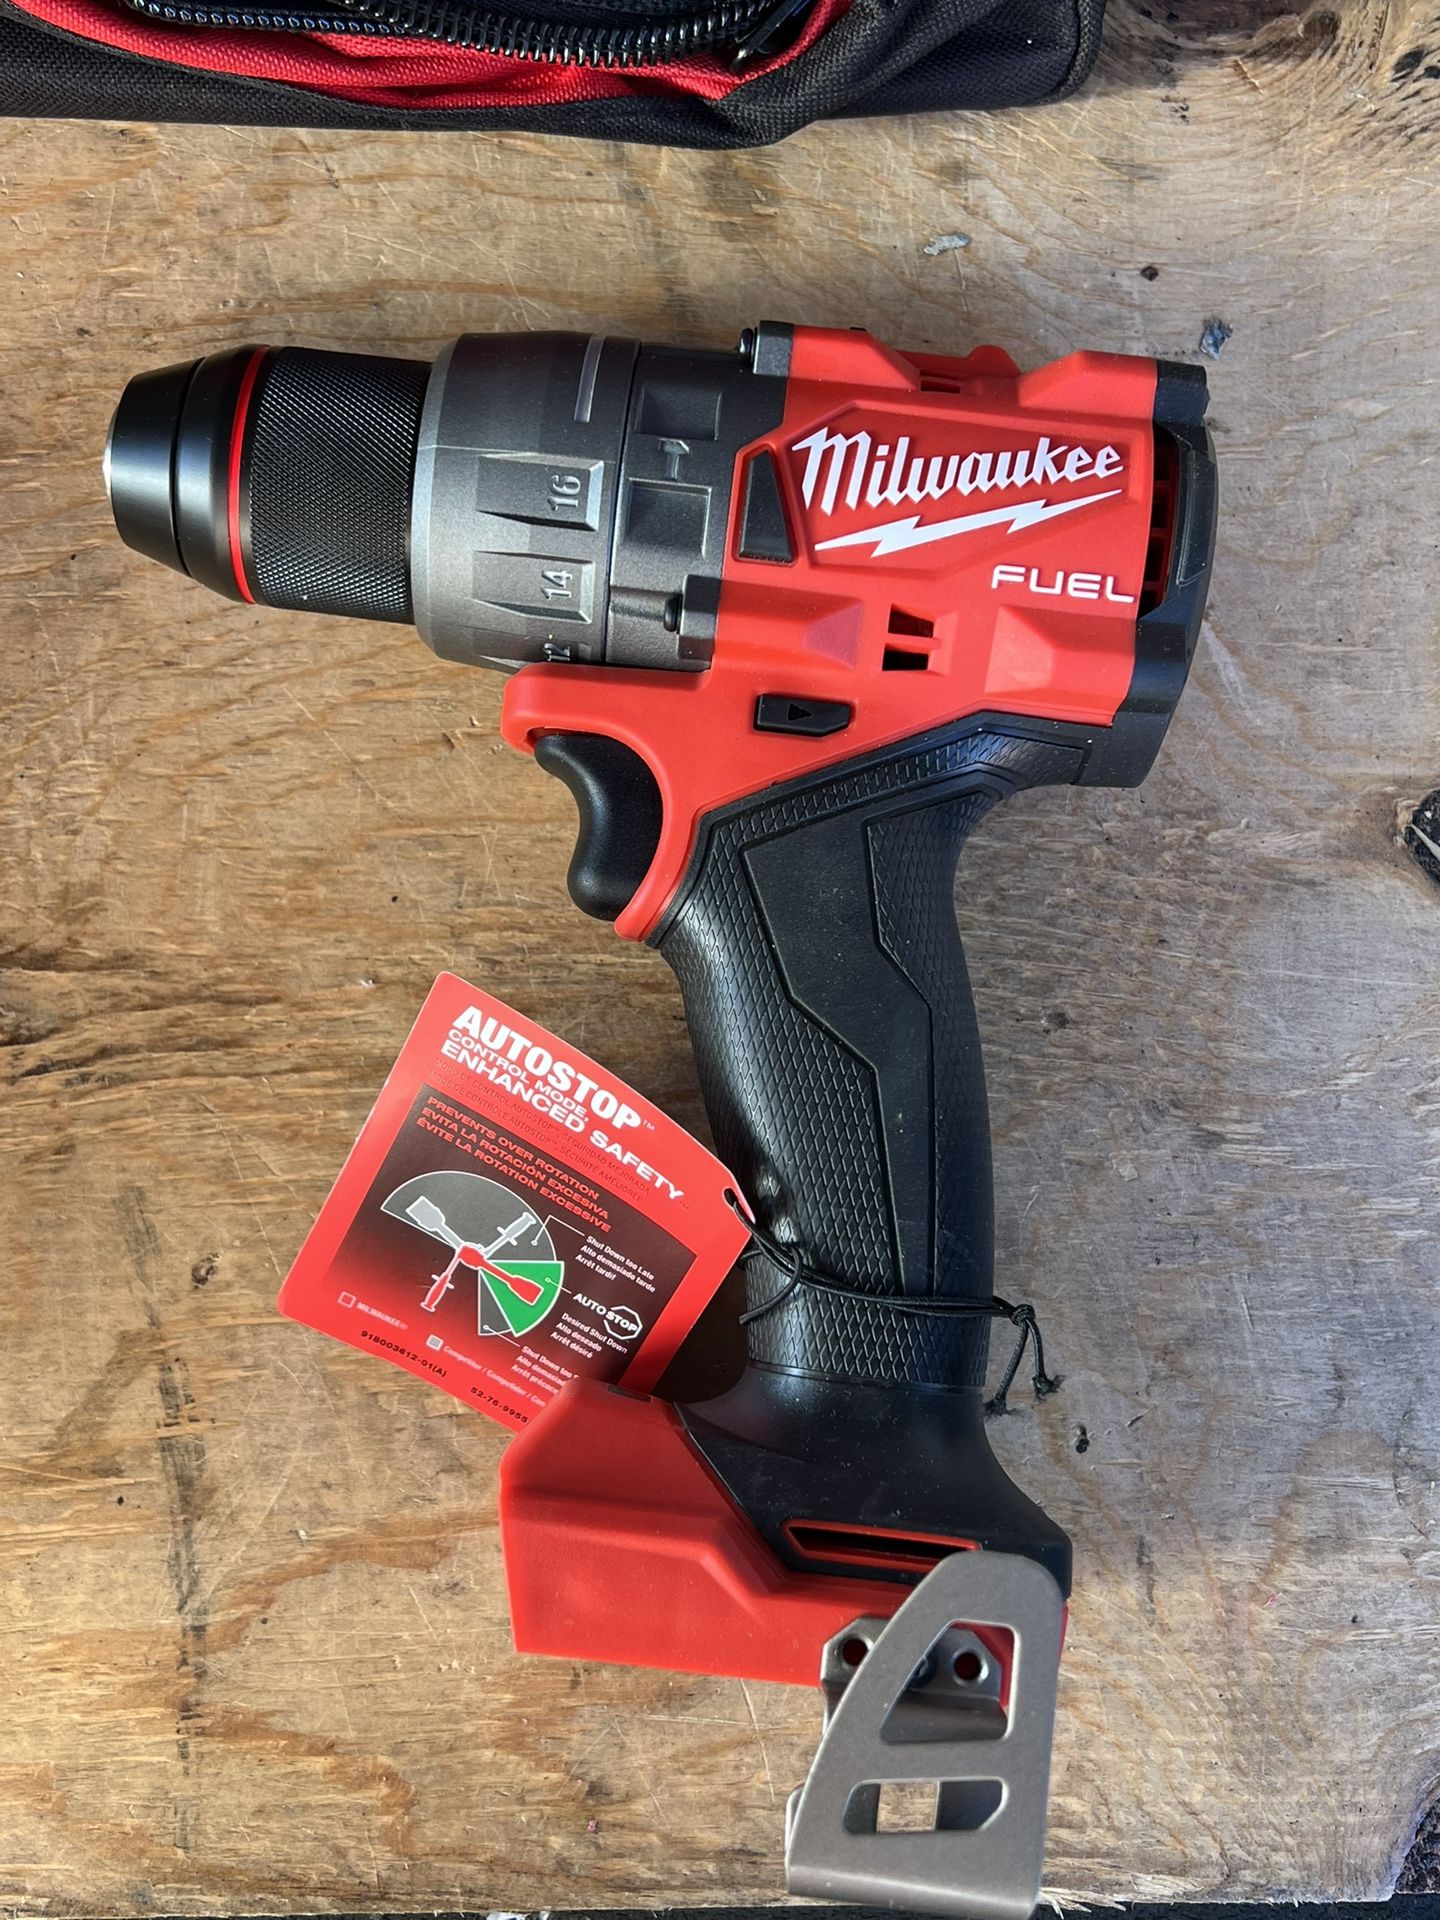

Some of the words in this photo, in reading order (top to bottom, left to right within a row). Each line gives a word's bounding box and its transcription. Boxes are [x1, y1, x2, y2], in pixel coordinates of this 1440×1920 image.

[791, 426, 1124, 516] Milwaukee
[547, 474, 581, 512] 16
[540, 570, 573, 600] 14
[991, 564, 1135, 603] FUEL
[440, 1038, 587, 1132] ENHANCED
[448, 1028, 529, 1083] CONTROL
[534, 1079, 588, 1121] MODE,
[425, 1094, 496, 1139] PREVENTS
[497, 1136, 534, 1161] OVER
[534, 1157, 599, 1200] ROTATION
[458, 1071, 472, 1084] DE
[471, 1079, 509, 1106] CONTROL
[561, 1132, 607, 1165] SEGURIDAD
[607, 1161, 651, 1194] MEJORADA
[415, 1115, 454, 1142] ÉVITE
[454, 1137, 471, 1153] LA
[473, 1148, 538, 1190] ROTATION
[539, 1185, 611, 1232] EXCESSIVE
[420, 1105, 458, 1132] EVITA
[459, 1127, 479, 1143] LA
[478, 1137, 546, 1181] ROTACIÓN
[546, 1177, 608, 1219] EXCESIVA
[575, 1254, 595, 1268] Arrêt
[594, 1264, 616, 1280] tardif
[580, 1245, 596, 1257] Alto
[596, 1254, 635, 1280] demasiado
[635, 1276, 655, 1292] tarde
[586, 1235, 604, 1250] Shut
[603, 1245, 625, 1262] Down
[625, 1258, 637, 1269] too
[637, 1265, 654, 1280] Late
[550, 1331, 570, 1346] Arrêt
[555, 1321, 571, 1334] Alto
[571, 1331, 601, 1351] deseado
[561, 1312, 590, 1332] Desired
[588, 1328, 607, 1342] Shut
[605, 1337, 627, 1353] Down
[516, 1355, 532, 1366] Alto
[521, 1345, 540, 1359] Shut
[538, 1355, 560, 1371] Down
[559, 1367, 572, 1378] too
[470, 1386, 528, 1423] 52-76-9955
